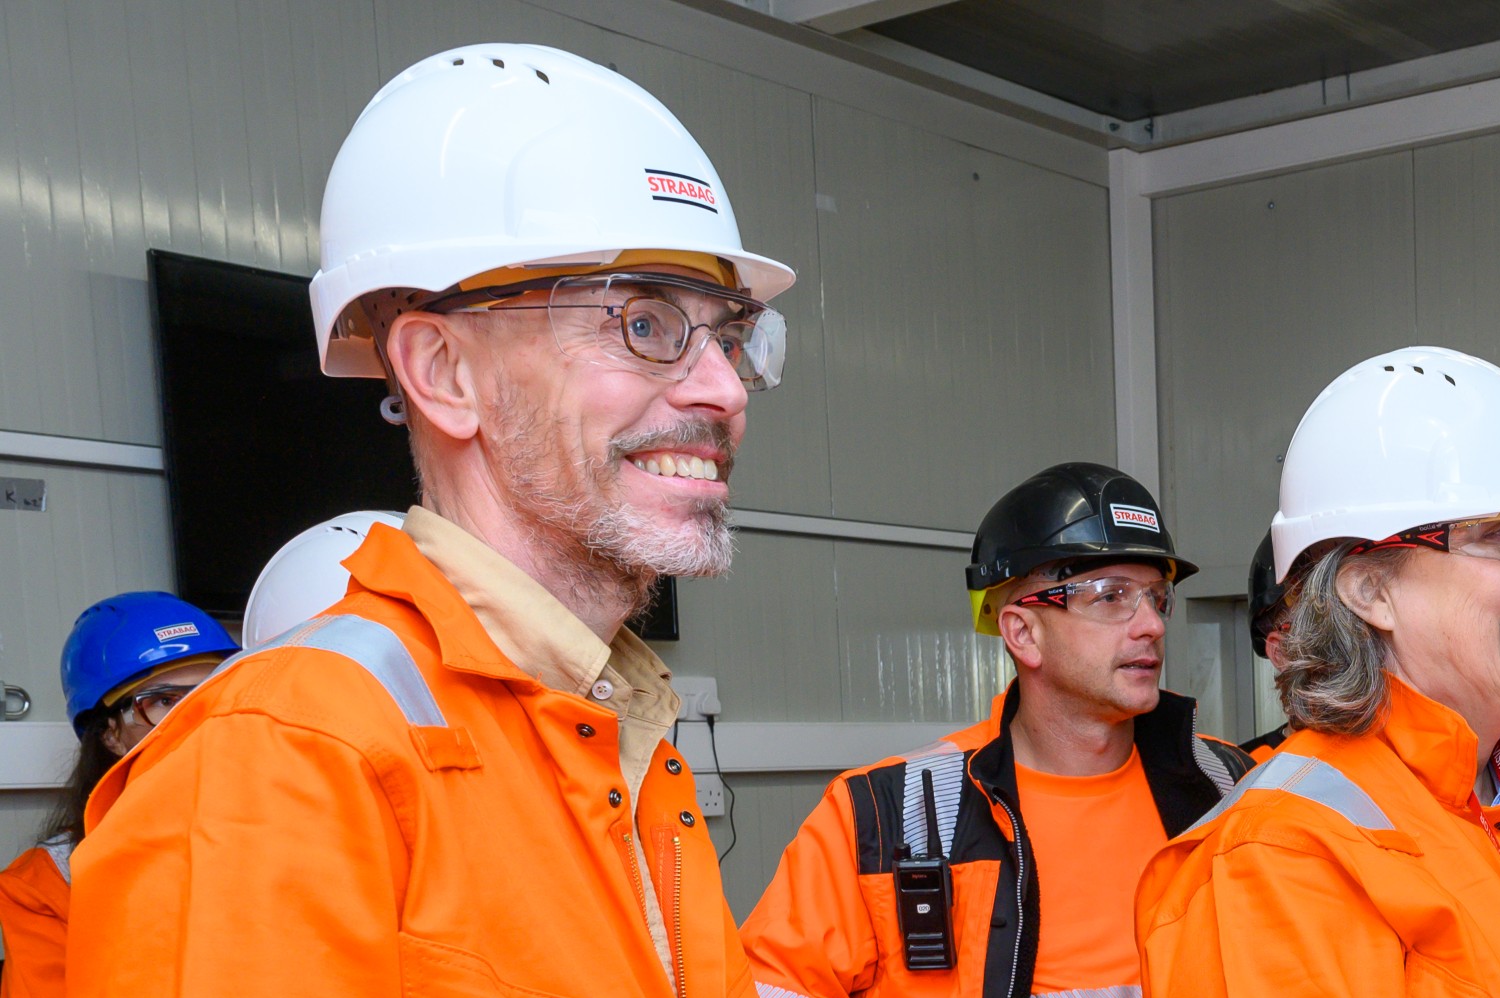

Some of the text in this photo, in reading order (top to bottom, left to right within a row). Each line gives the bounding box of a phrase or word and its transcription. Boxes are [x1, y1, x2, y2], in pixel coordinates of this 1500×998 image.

[647, 176, 715, 205] STRABAG
[1113, 510, 1156, 526] STRABAG
[157, 625, 197, 639] STRABAG
